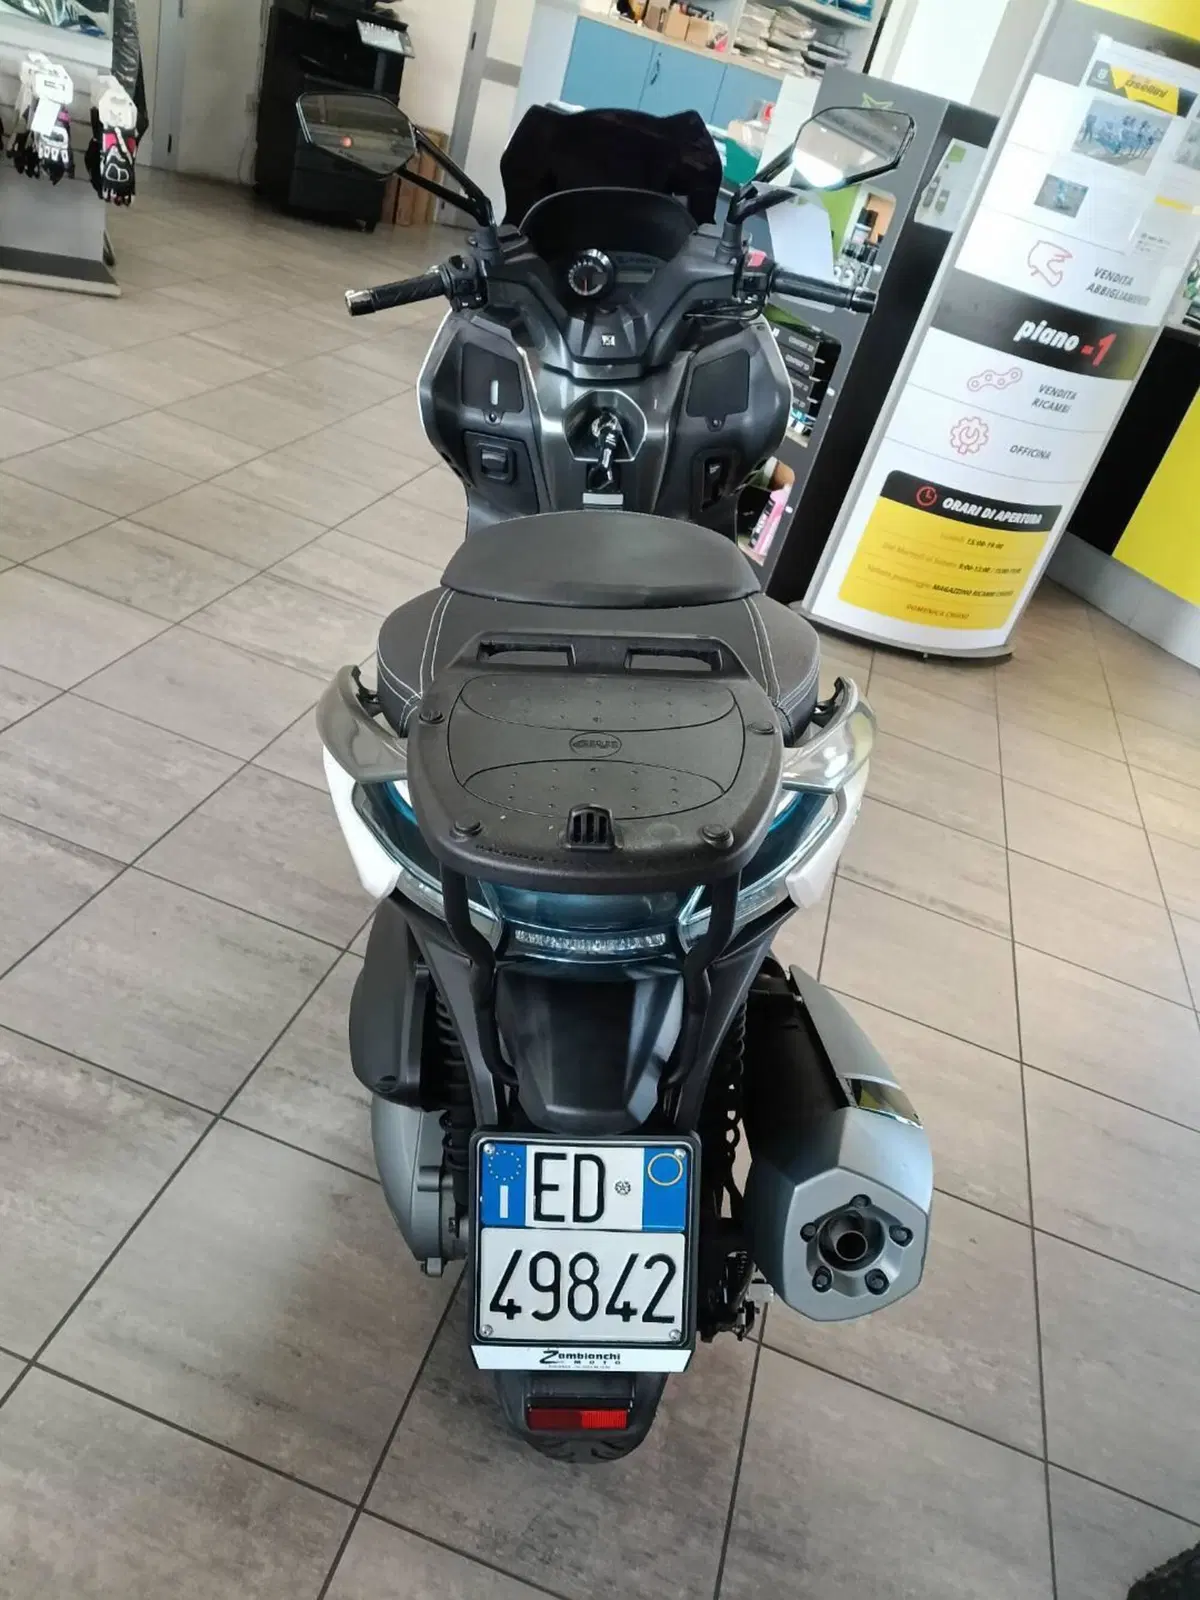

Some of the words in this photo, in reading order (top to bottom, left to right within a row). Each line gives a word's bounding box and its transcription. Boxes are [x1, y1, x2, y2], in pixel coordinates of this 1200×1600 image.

[1094, 266, 1134, 286] VENDITA
[1013, 320, 1080, 351] piano
[1080, 332, 1117, 368] -1
[1038, 384, 1078, 400] VENDITA
[1031, 398, 1072, 414] RICAMBI
[1010, 445, 1051, 460] OFFICINA
[942, 497, 982, 516] ORARI
[981, 508, 997, 519] DI
[994, 510, 1043, 524] APERTURA
[533, 1152, 606, 1223] ED
[489, 1249, 677, 1324] 49842
[539, 1350, 621, 1364] Zambianchi
